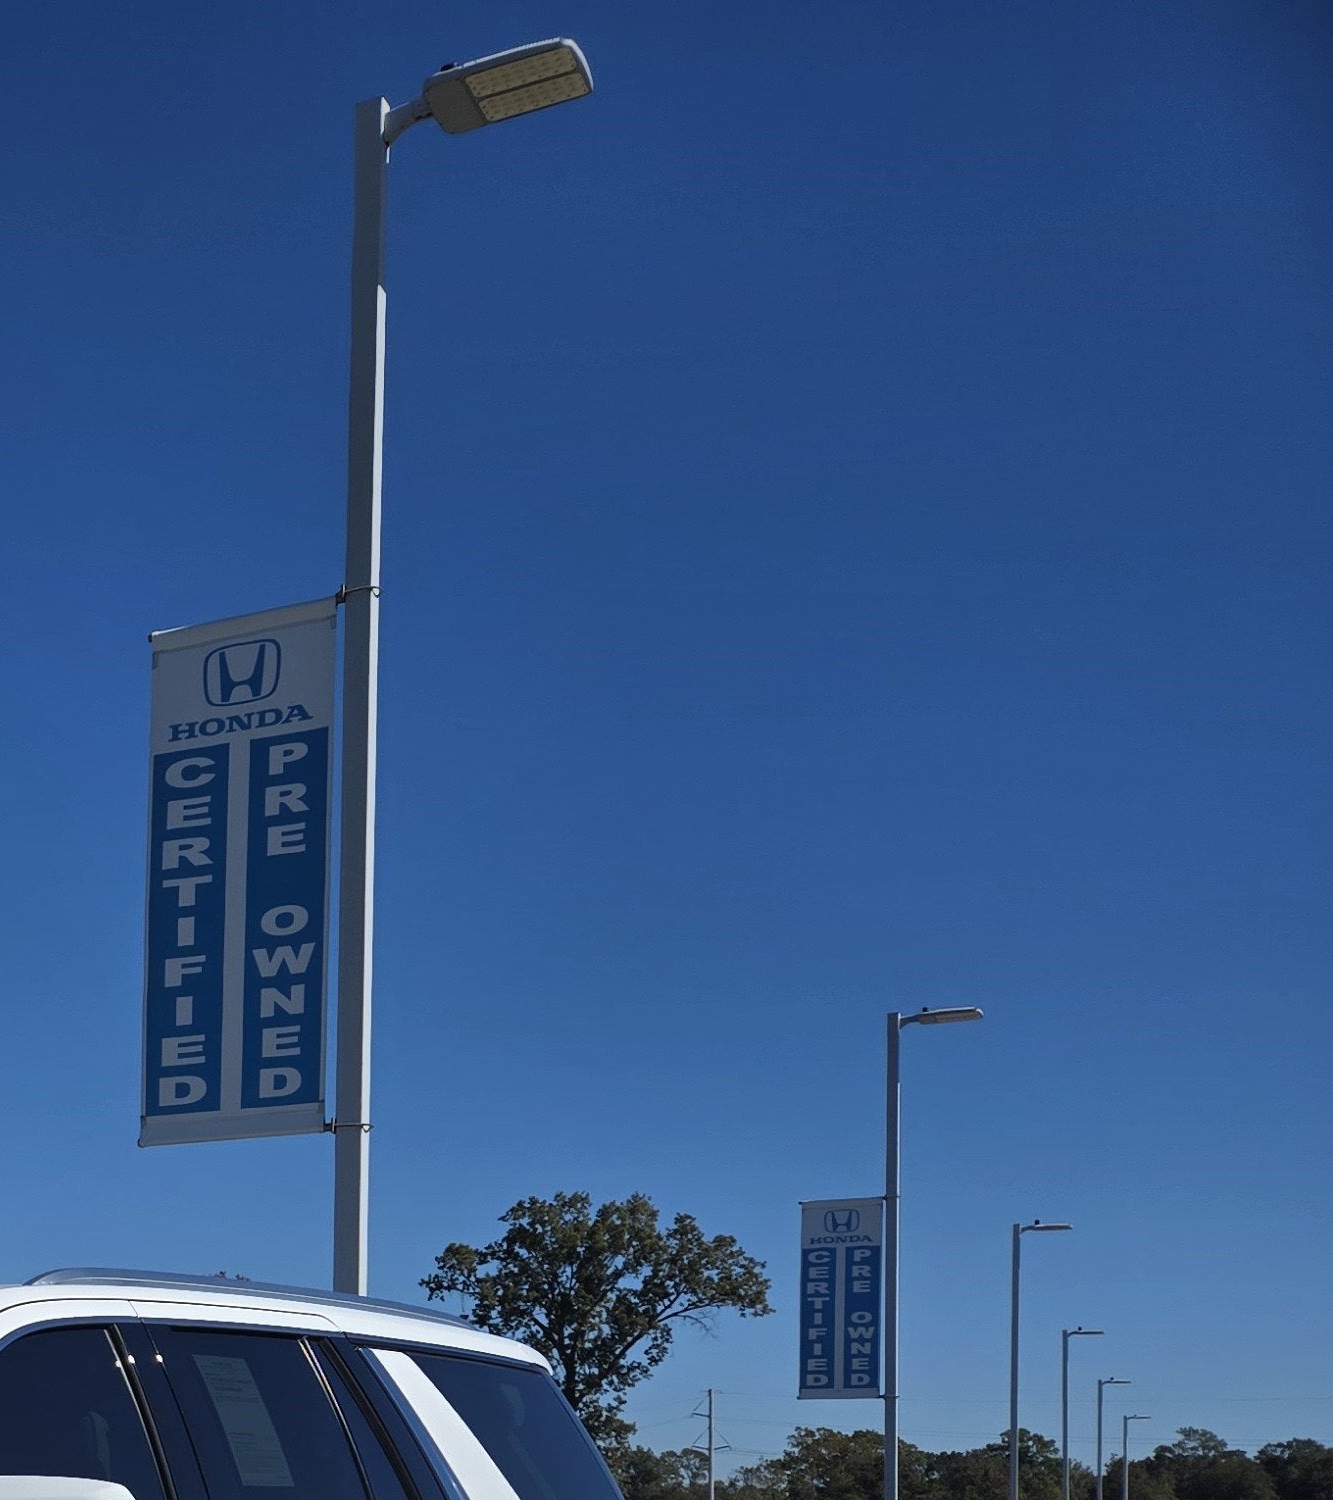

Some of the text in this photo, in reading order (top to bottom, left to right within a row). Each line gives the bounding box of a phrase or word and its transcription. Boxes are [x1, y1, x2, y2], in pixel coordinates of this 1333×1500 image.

[167, 703, 314, 742] HONDA
[158, 756, 217, 1107] CERTIFIED
[252, 741, 316, 1099] PRE OWNED
[809, 1234, 873, 1245] HONDA
[806, 1250, 831, 1387] CERTIFIED
[847, 1248, 876, 1386] PRE OWNED
